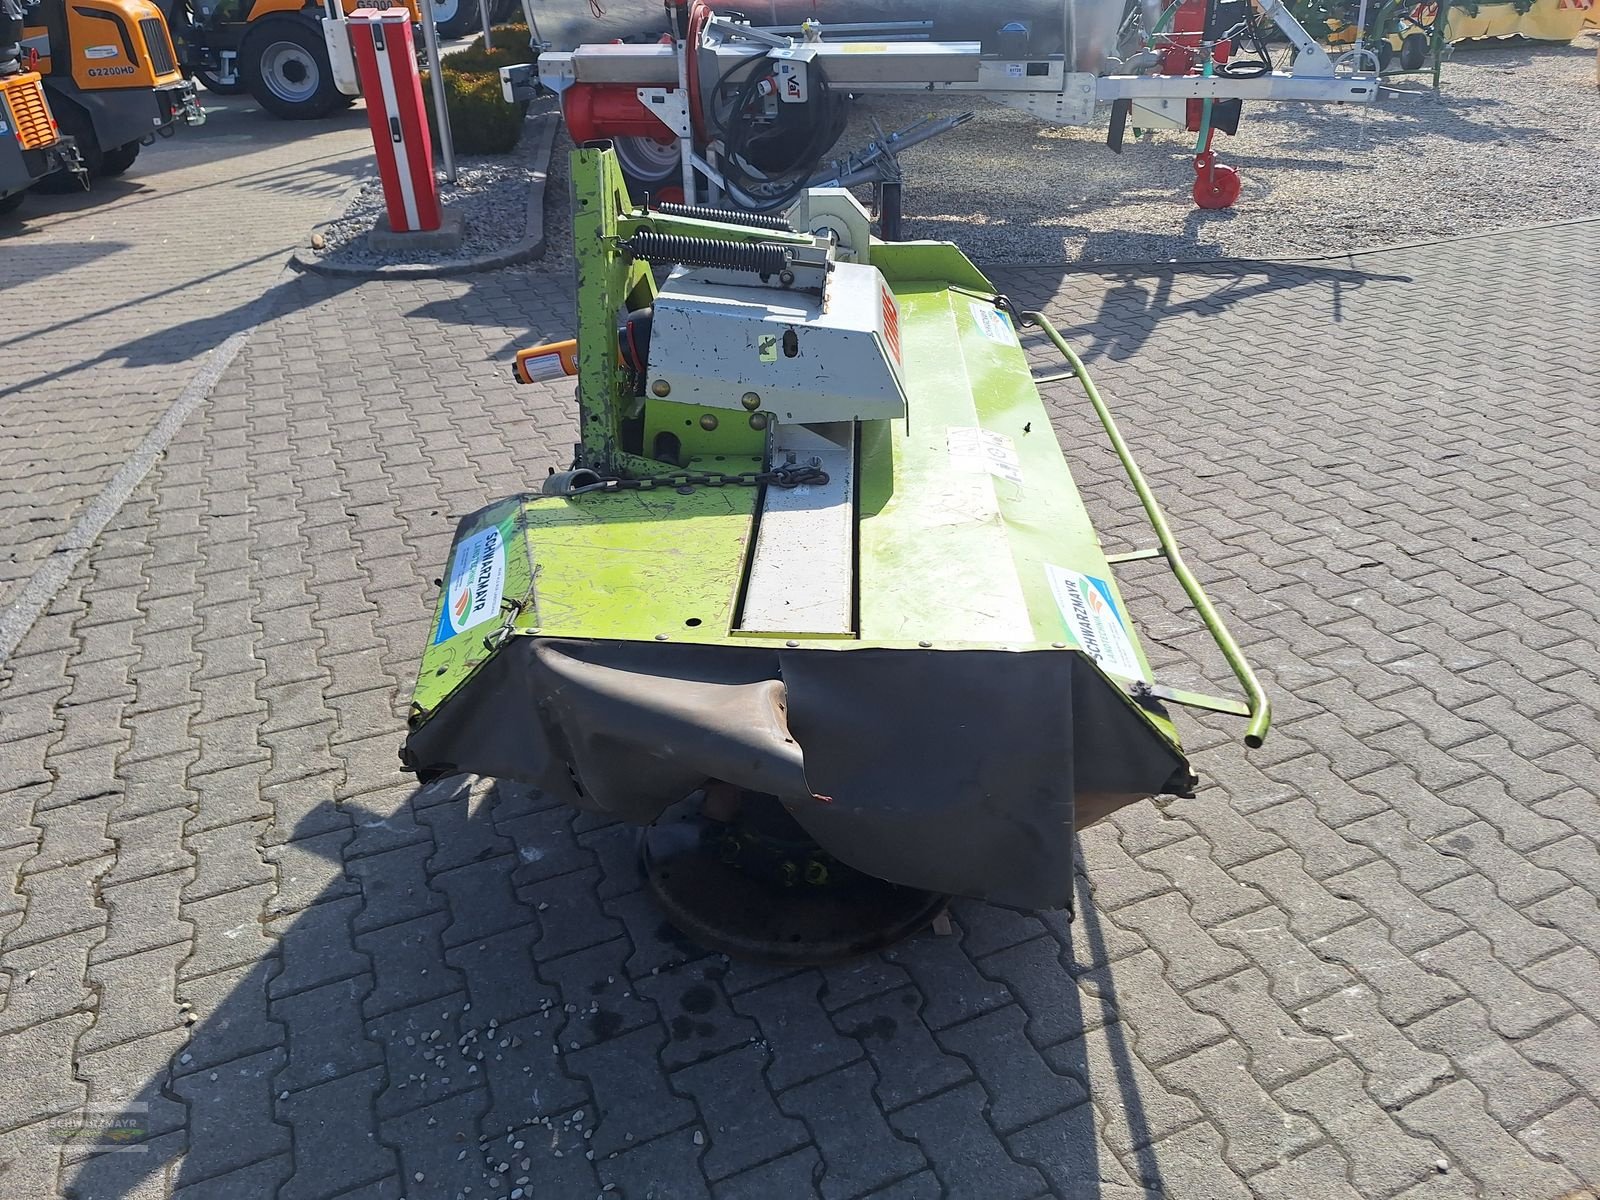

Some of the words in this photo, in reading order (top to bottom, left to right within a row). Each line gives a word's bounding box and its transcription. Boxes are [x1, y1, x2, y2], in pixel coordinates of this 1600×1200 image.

[357, 0, 392, 10] G5000
[88, 66, 135, 77] G2200HD
[473, 531, 498, 613] SCHWARZMAYR
[1065, 579, 1104, 661] SCHWARZMAYR
